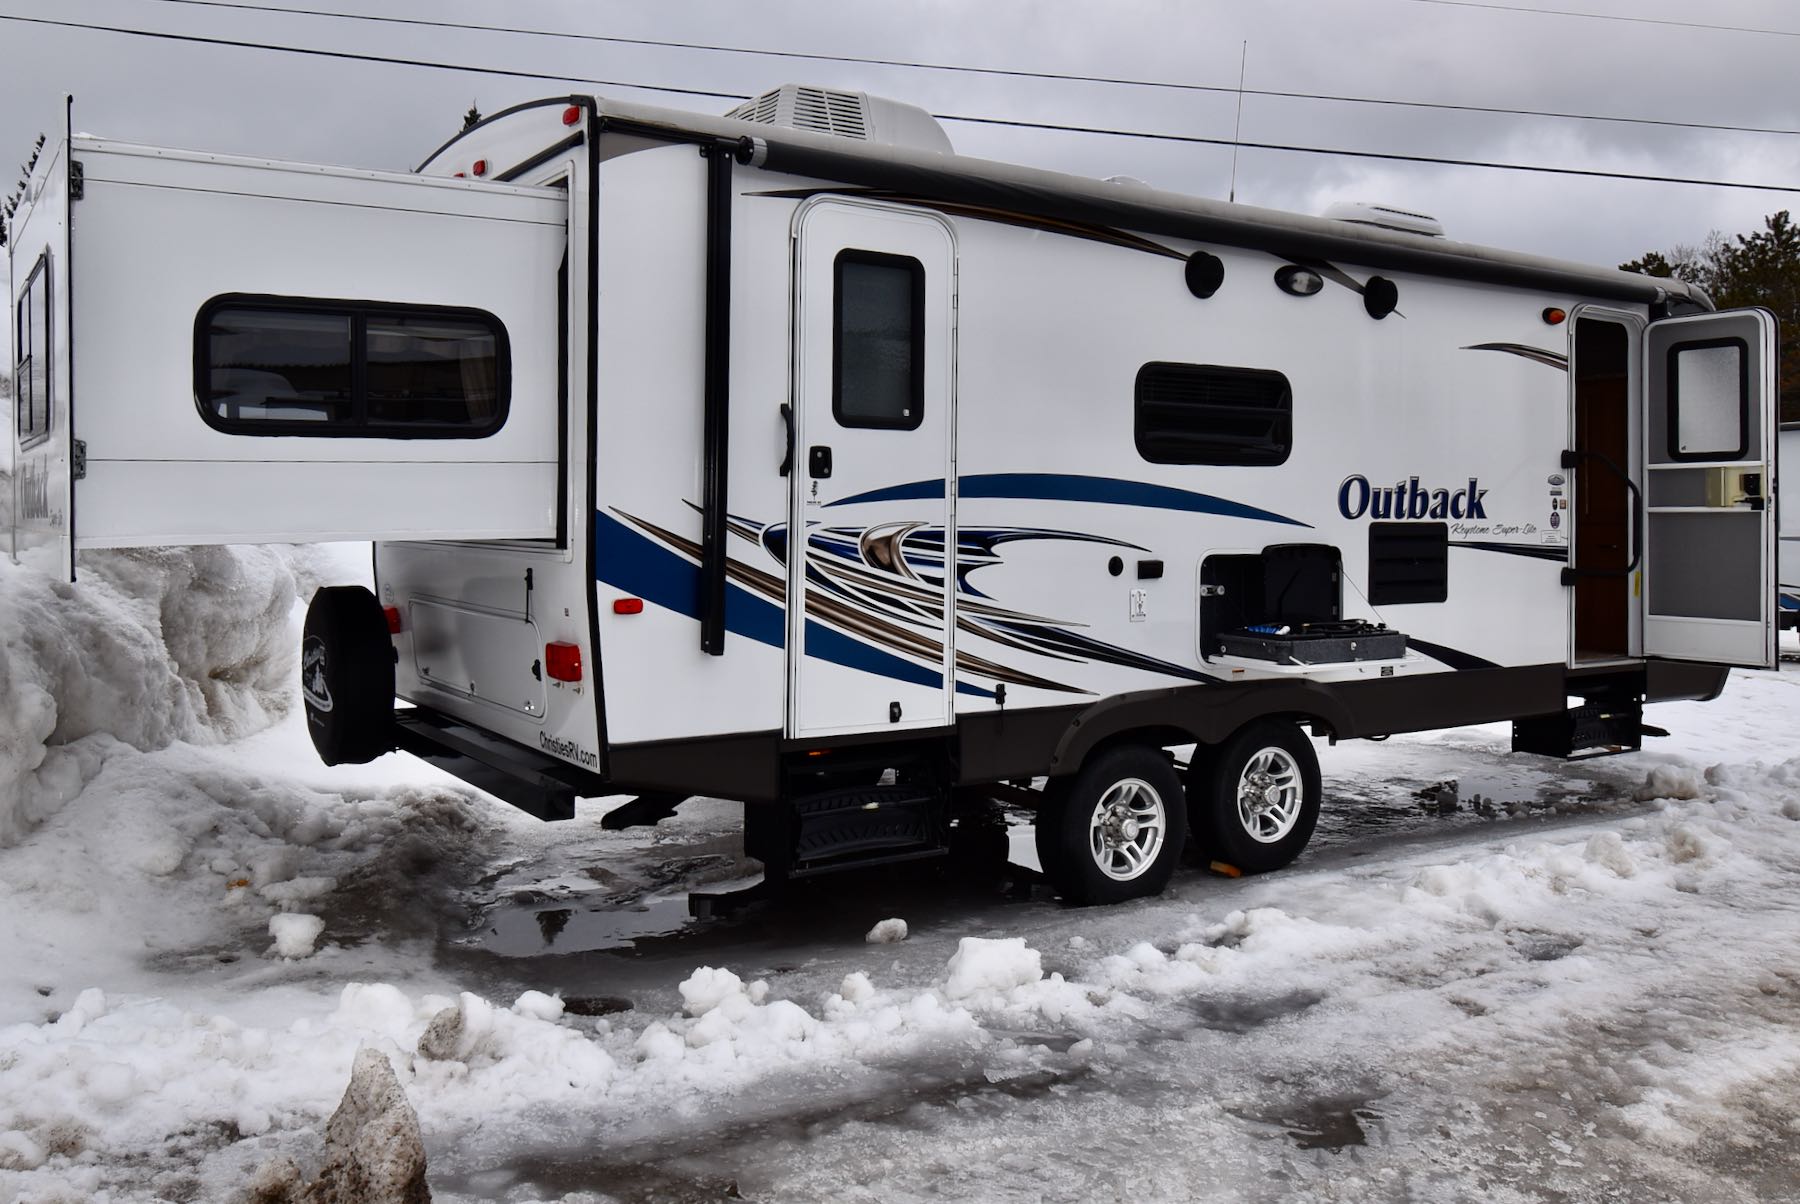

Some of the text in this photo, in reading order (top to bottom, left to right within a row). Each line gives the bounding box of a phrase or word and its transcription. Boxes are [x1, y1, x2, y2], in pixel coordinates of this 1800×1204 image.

[1338, 473, 1489, 520] Outback
[1450, 523, 1537, 539] Keystone Super-Lite
[540, 730, 597, 768] ChristiesRV.com
